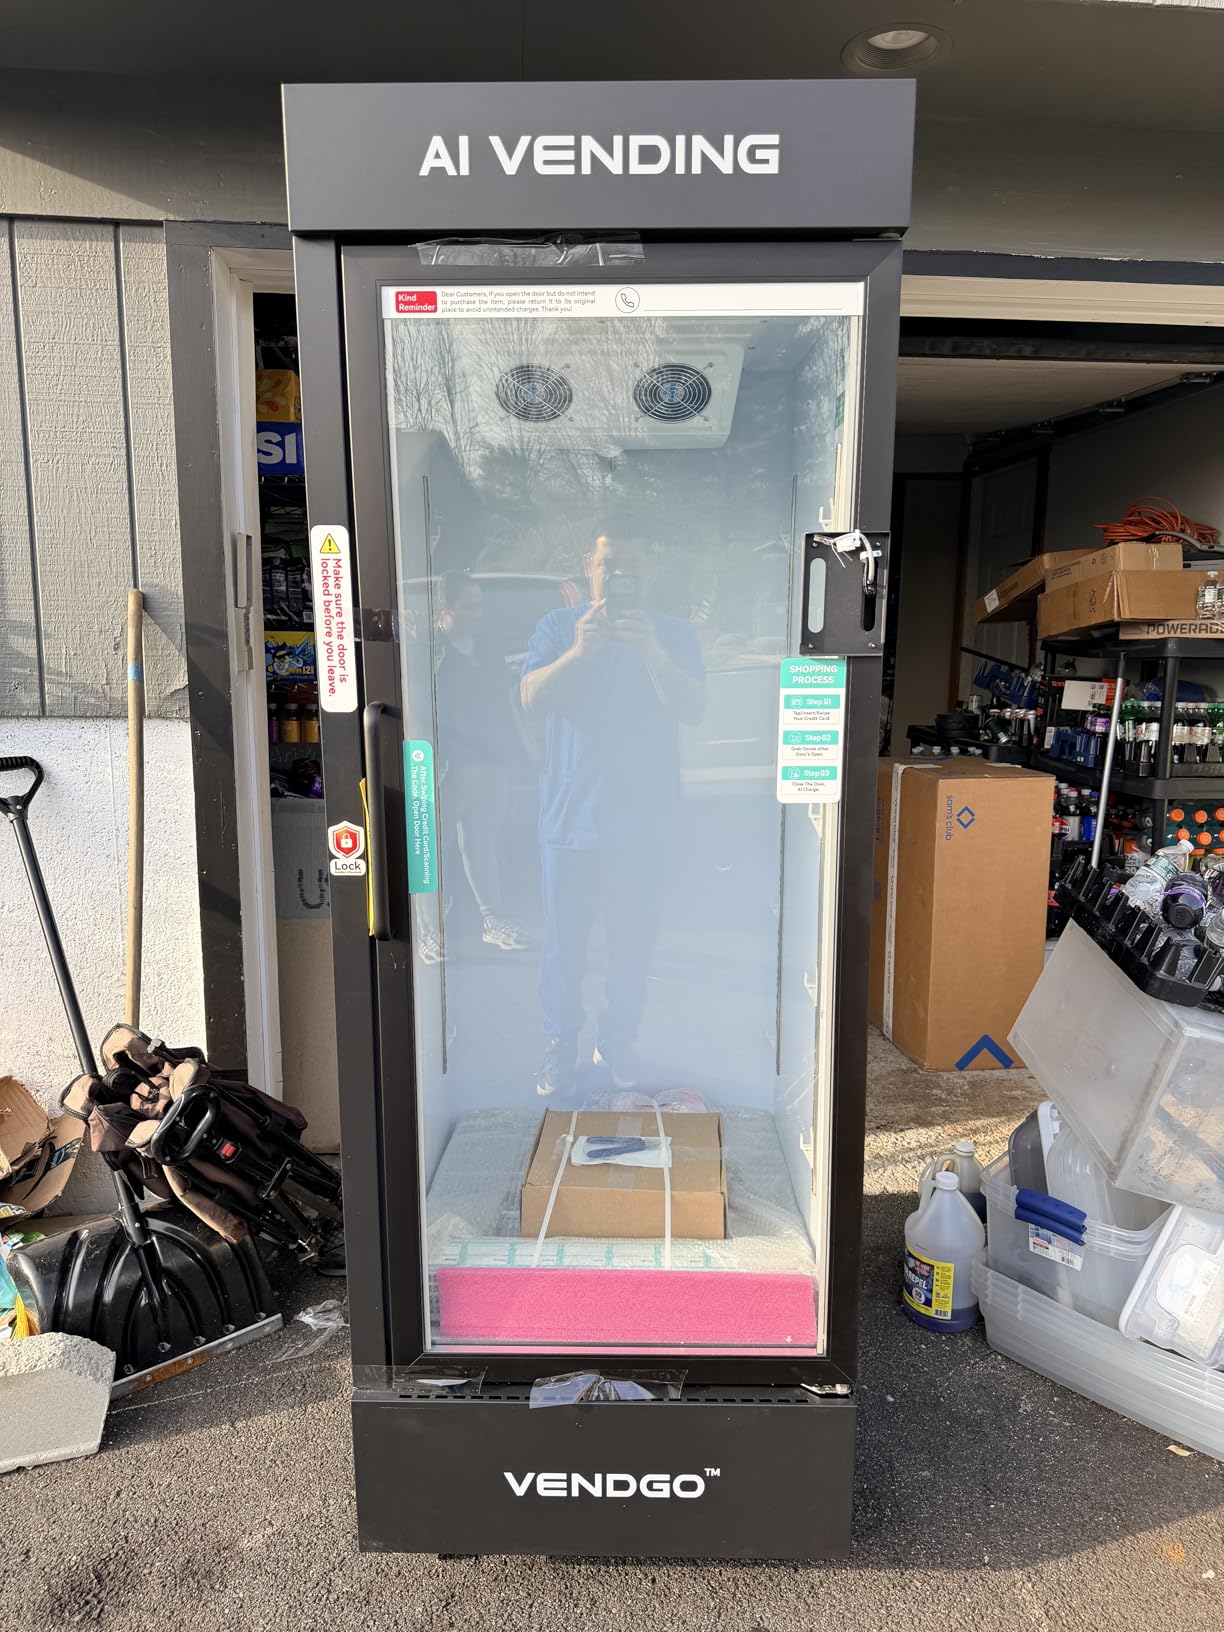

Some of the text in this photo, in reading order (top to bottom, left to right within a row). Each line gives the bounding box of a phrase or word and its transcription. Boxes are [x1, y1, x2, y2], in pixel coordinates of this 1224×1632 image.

[419, 134, 780, 176] AI VENDING
[398, 293, 417, 302] Kind
[456, 291, 488, 299] Customers,
[398, 303, 437, 312] Reminder
[321, 558, 337, 697] locked before you leave.
[333, 558, 349, 683] Make sure the door is
[790, 665, 838, 674] SHOPPING
[792, 676, 835, 685] PROCESS
[807, 698, 822, 706] Step
[420, 786, 428, 812] Swiping
[412, 801, 420, 820] Open
[945, 795, 954, 841] sam's club
[335, 861, 361, 871] Lock
[423, 836, 431, 884] Card/Scanning
[503, 1472, 706, 1499] VENDGO
